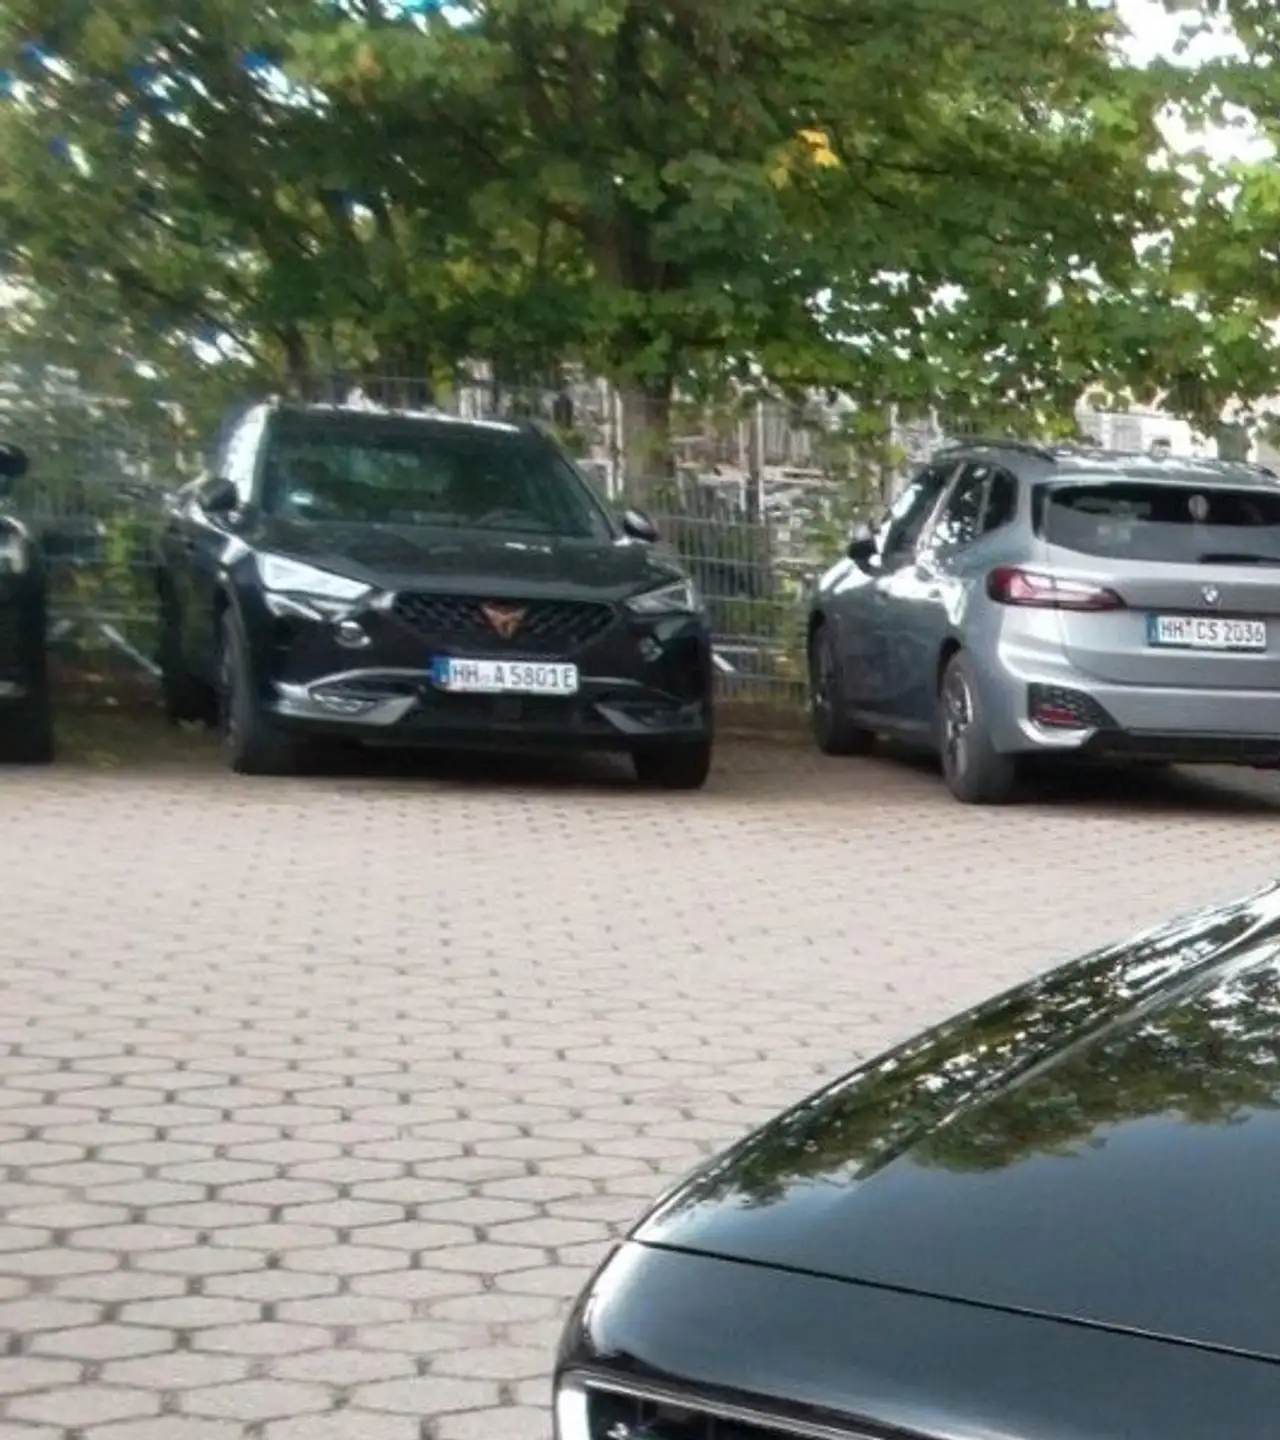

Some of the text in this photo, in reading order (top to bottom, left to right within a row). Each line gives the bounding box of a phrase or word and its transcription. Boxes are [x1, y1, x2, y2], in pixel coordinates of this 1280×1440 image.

[1160, 620, 1264, 643] HH CS 2036
[454, 663, 478, 683] HH
